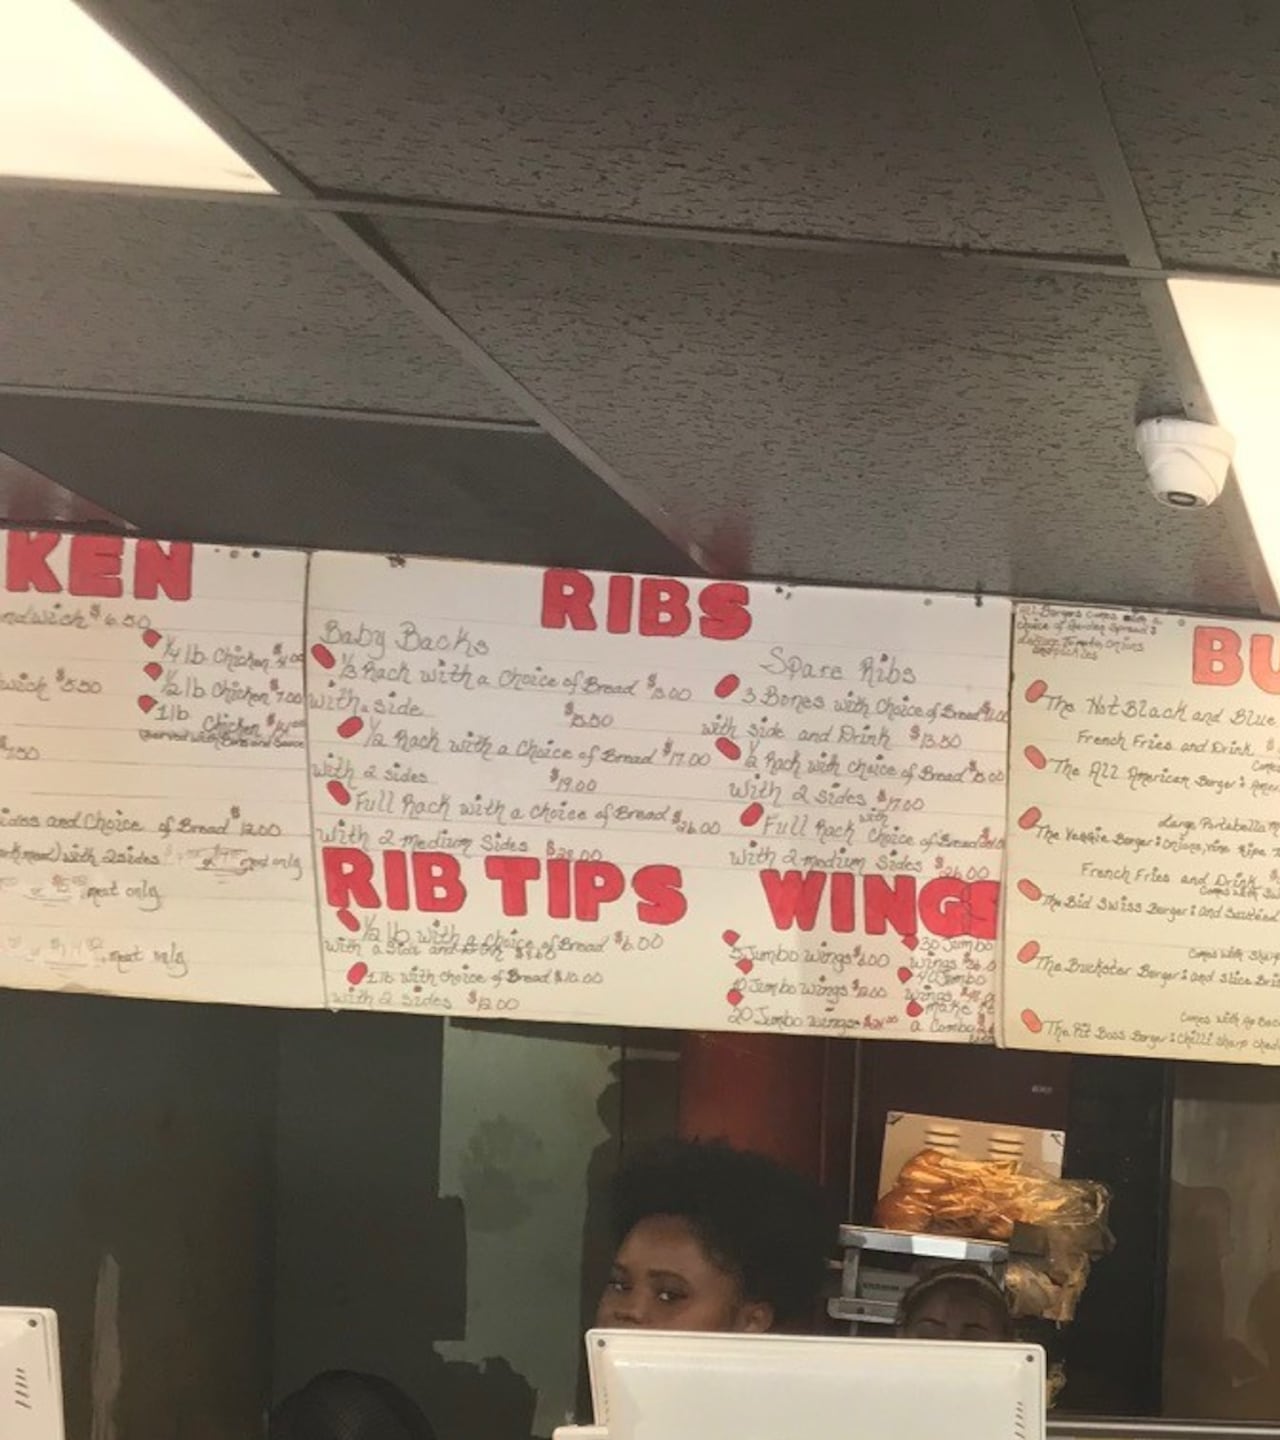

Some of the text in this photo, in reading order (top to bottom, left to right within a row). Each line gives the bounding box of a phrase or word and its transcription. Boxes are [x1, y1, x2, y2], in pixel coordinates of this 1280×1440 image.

[6, 530, 193, 601] KEN
[541, 567, 753, 640] RIBS
[320, 619, 491, 661] Baby Backs
[419, 659, 640, 698] with Bread
[758, 646, 842, 691] Spare
[374, 690, 425, 718] side
[760, 684, 825, 711] Bones
[1040, 694, 1276, 728] The Black and Blue
[448, 731, 496, 762] with
[798, 724, 893, 750] and Drink
[1076, 728, 1257, 757] French Fries and Drink
[383, 760, 430, 785] sides
[1127, 757, 1190, 790] American
[355, 792, 506, 825] Full with
[815, 781, 868, 806] sides
[761, 813, 808, 836] Full
[322, 846, 688, 927] RIB TIPS
[1081, 860, 1258, 890] French Fries and Drink
[1096, 891, 1143, 916] Swiss
[746, 940, 852, 973] Jumbo wings
[400, 984, 452, 1010] sides
[749, 975, 848, 1005] Jumbo wings
[756, 1007, 803, 1027] Jumbo
[1094, 1024, 1128, 1042] Boss
